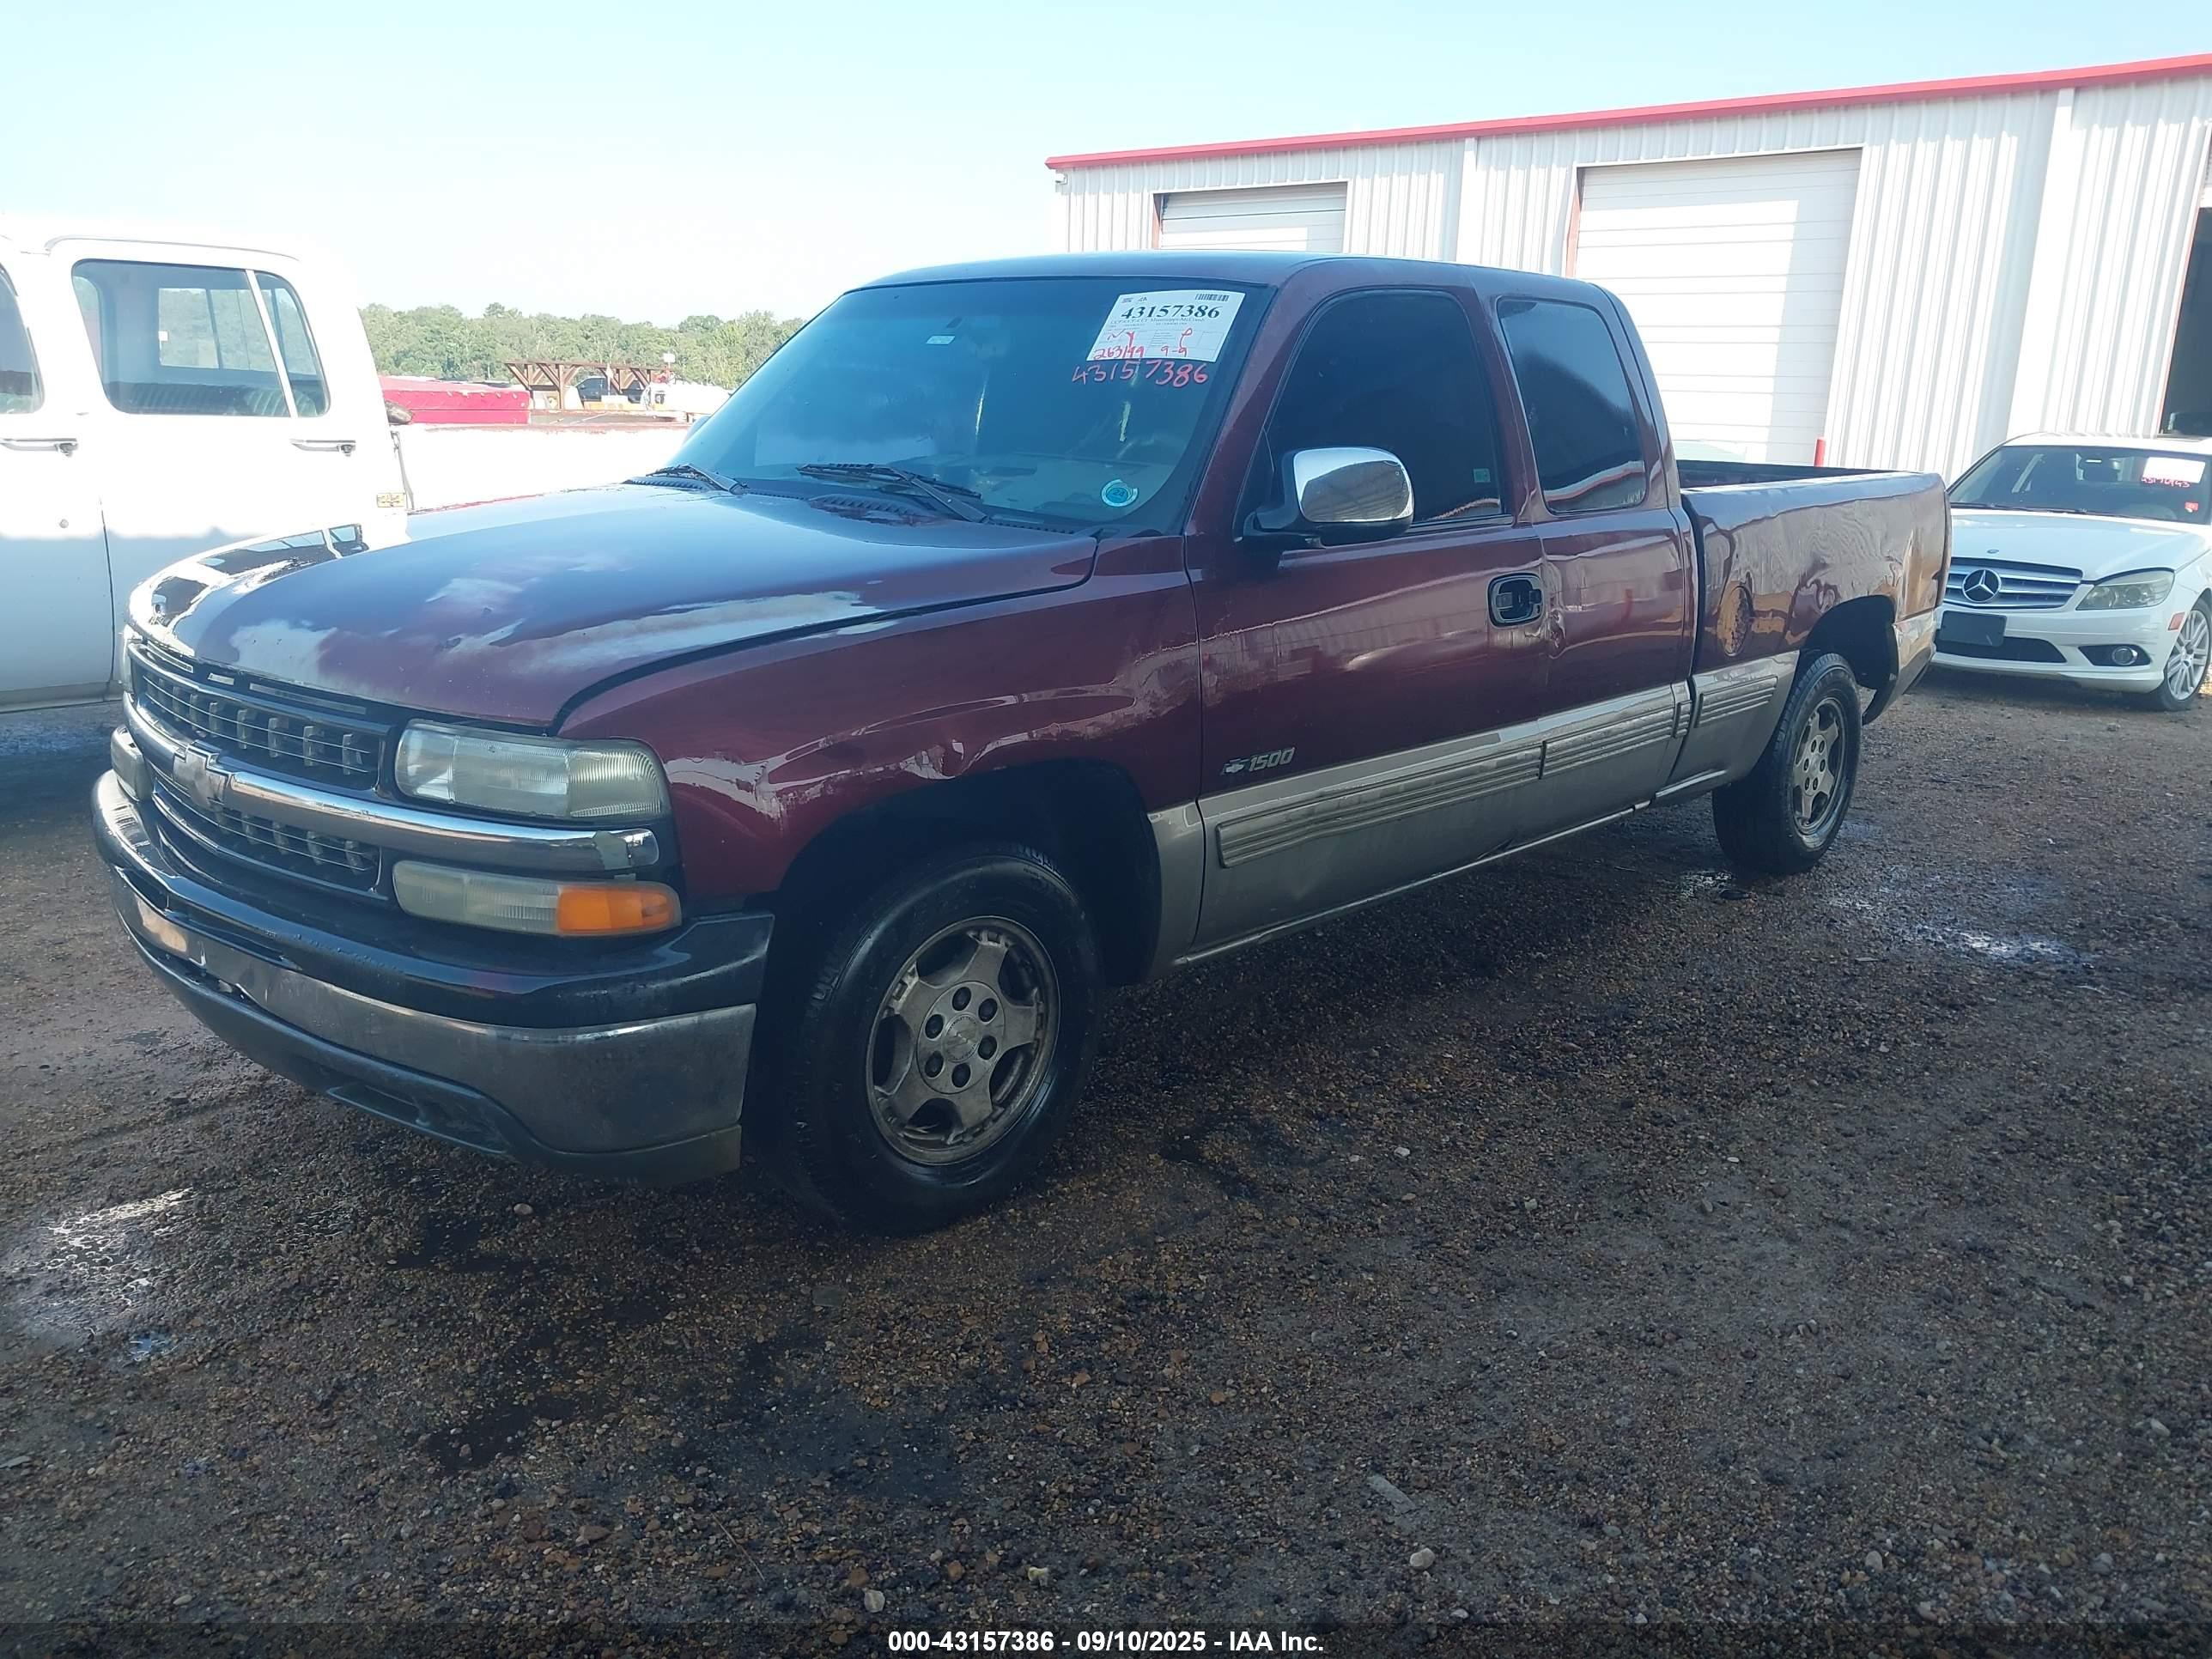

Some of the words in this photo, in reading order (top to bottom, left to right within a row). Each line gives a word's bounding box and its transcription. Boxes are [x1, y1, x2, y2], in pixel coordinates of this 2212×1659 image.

[1121, 304, 1222, 319] 43157386
[1072, 359, 1209, 388] 43157386
[1249, 747, 1296, 772] 1500
